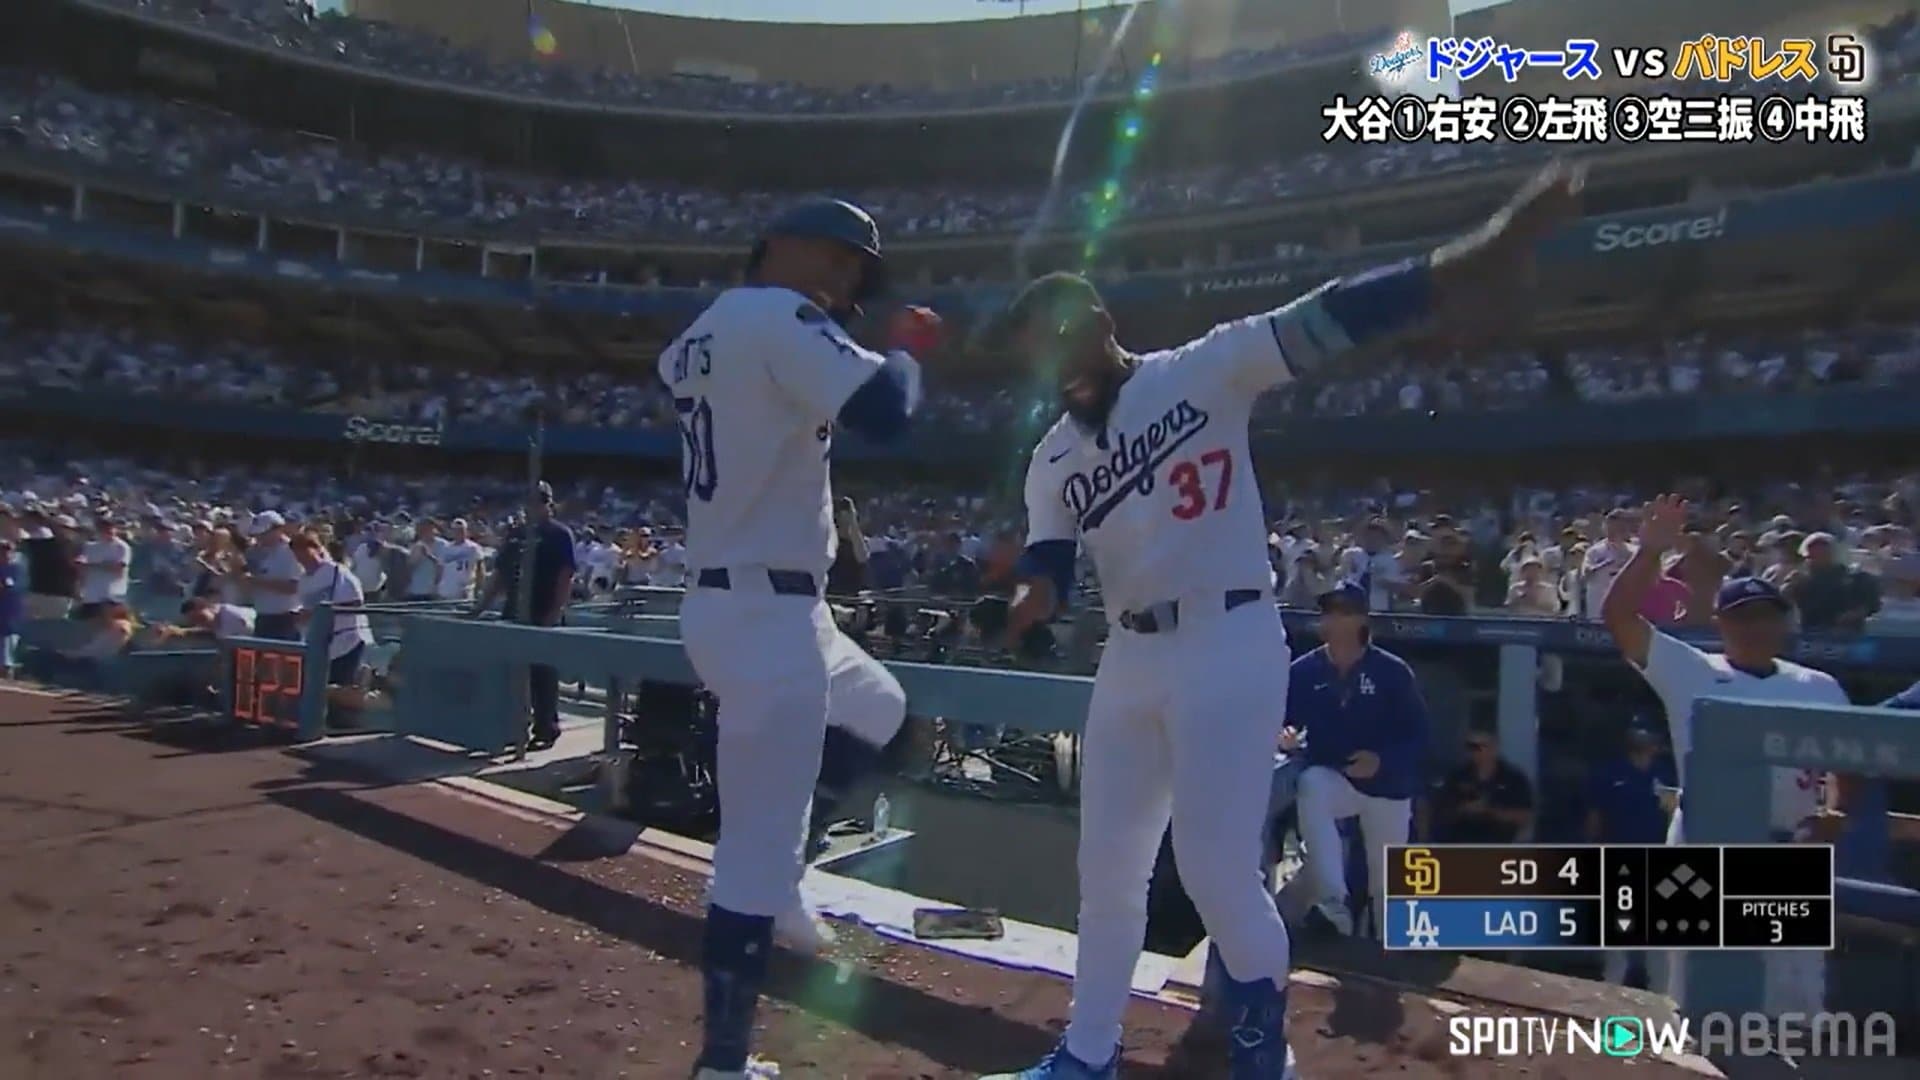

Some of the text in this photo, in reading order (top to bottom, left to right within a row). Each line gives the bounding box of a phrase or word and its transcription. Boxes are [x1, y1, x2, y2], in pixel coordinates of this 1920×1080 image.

[1594, 208, 1727, 251] Score!
[344, 416, 443, 445] Score!
[1063, 400, 1208, 532] Dodgers
[1168, 448, 1233, 521] 37
